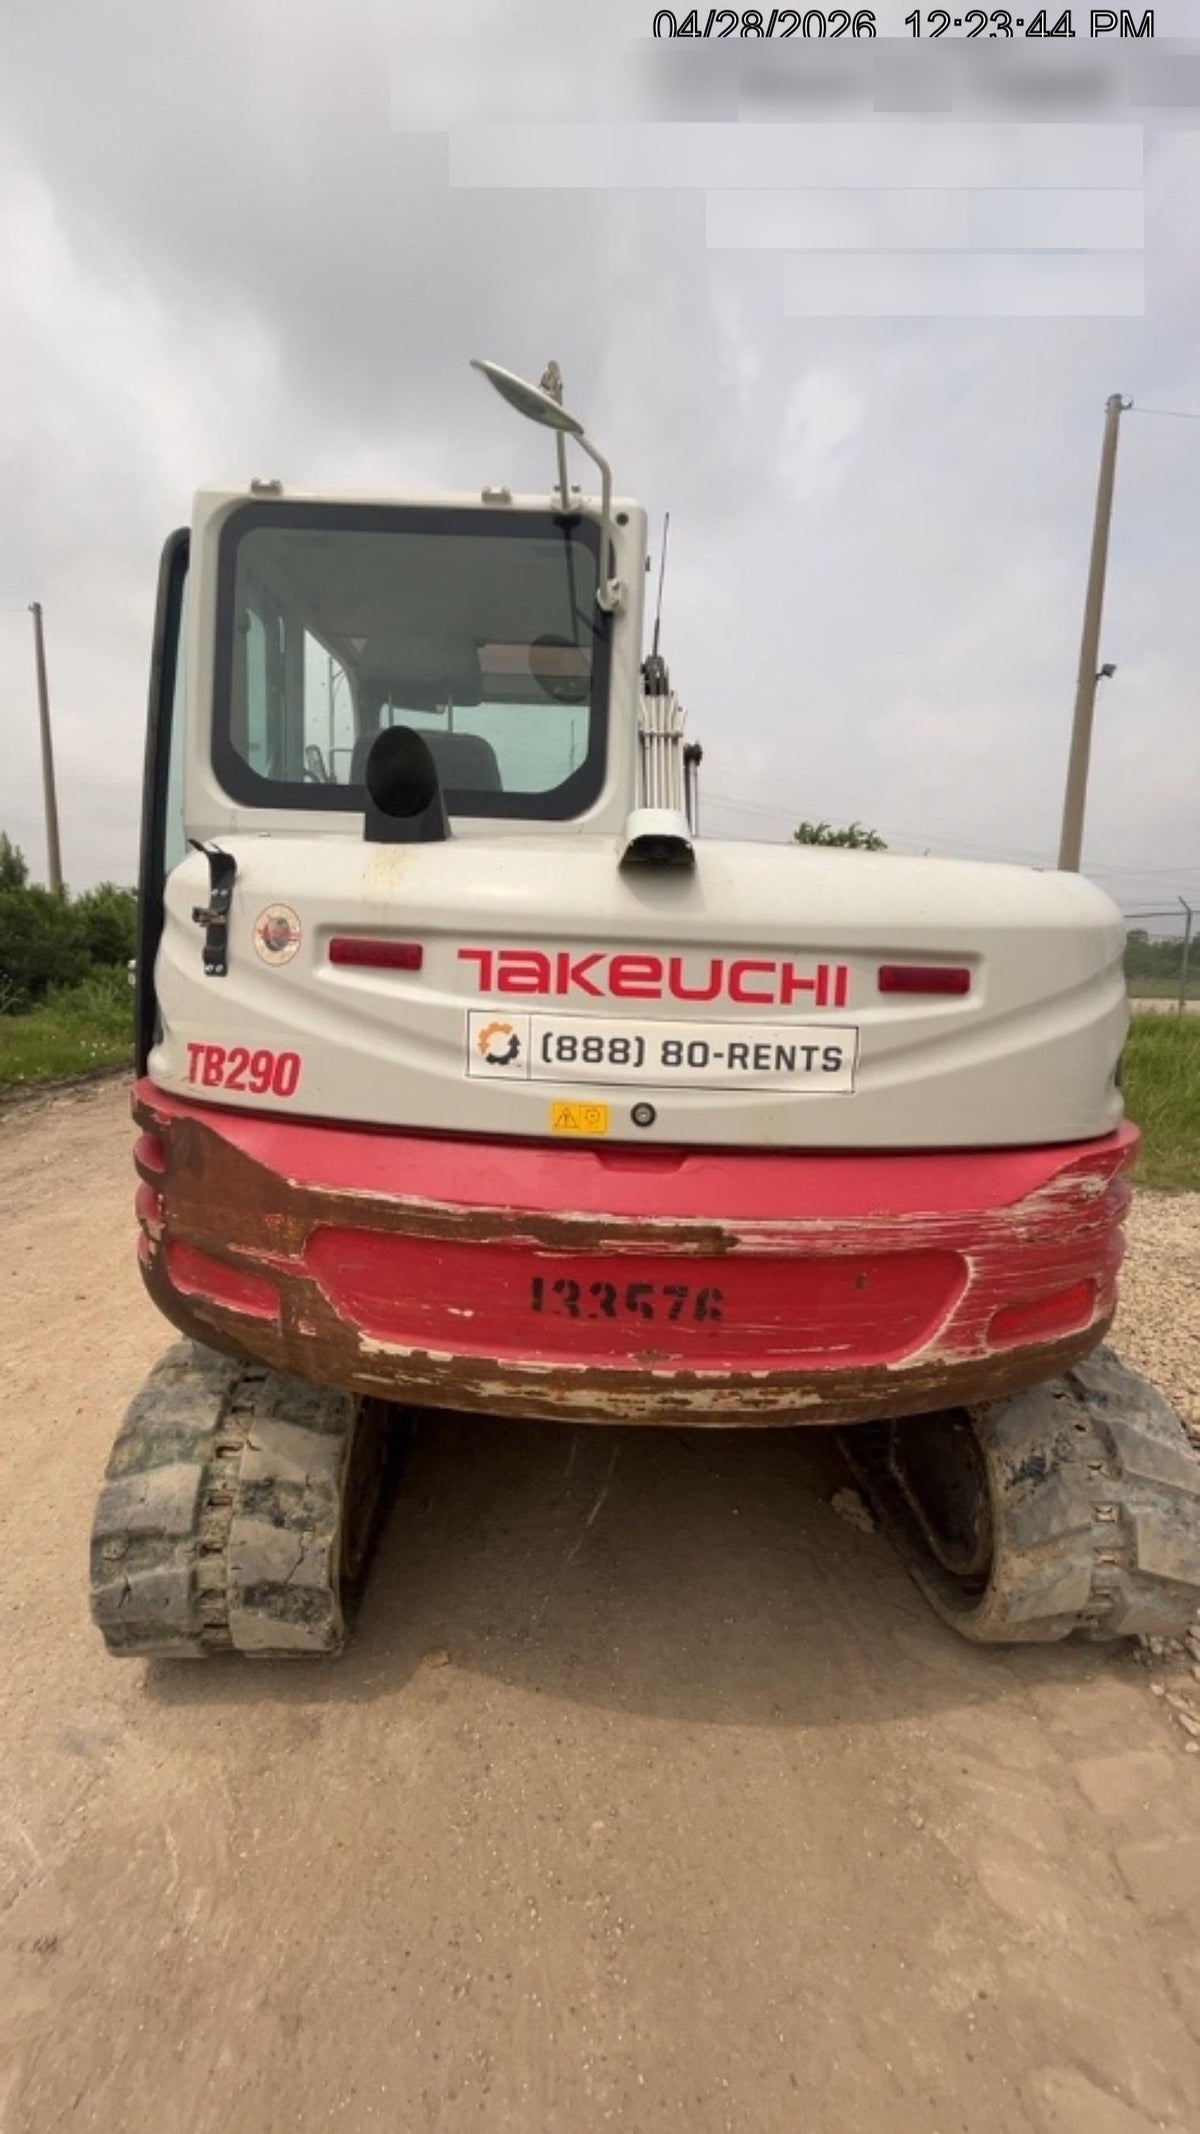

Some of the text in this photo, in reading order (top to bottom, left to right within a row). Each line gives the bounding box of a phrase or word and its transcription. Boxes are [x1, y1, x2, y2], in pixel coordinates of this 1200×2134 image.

[187, 1043, 301, 1097] TB290
[541, 1032, 843, 1072] (888) 80-RENTS
